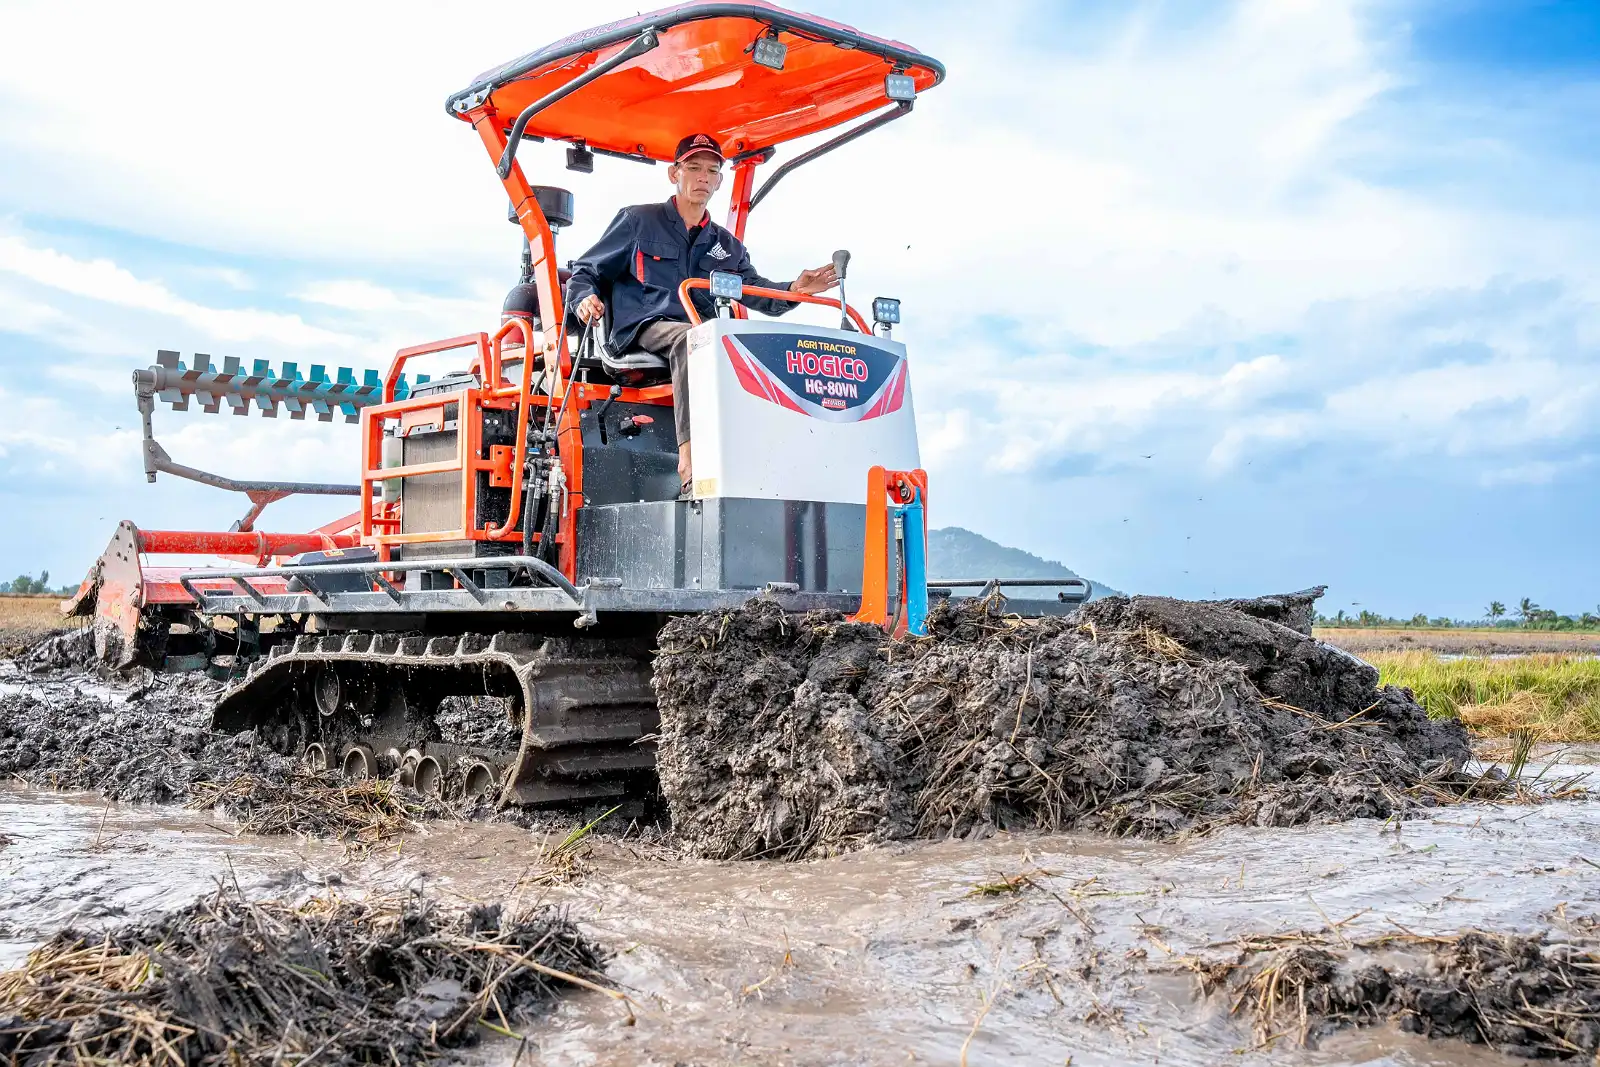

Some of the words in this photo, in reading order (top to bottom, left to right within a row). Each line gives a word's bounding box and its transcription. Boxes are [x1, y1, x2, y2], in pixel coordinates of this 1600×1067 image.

[797, 340, 817, 349] AGRI
[818, 341, 856, 355] TRACTOR
[786, 350, 868, 382] HOGICO
[805, 378, 858, 399] HG-80VN
